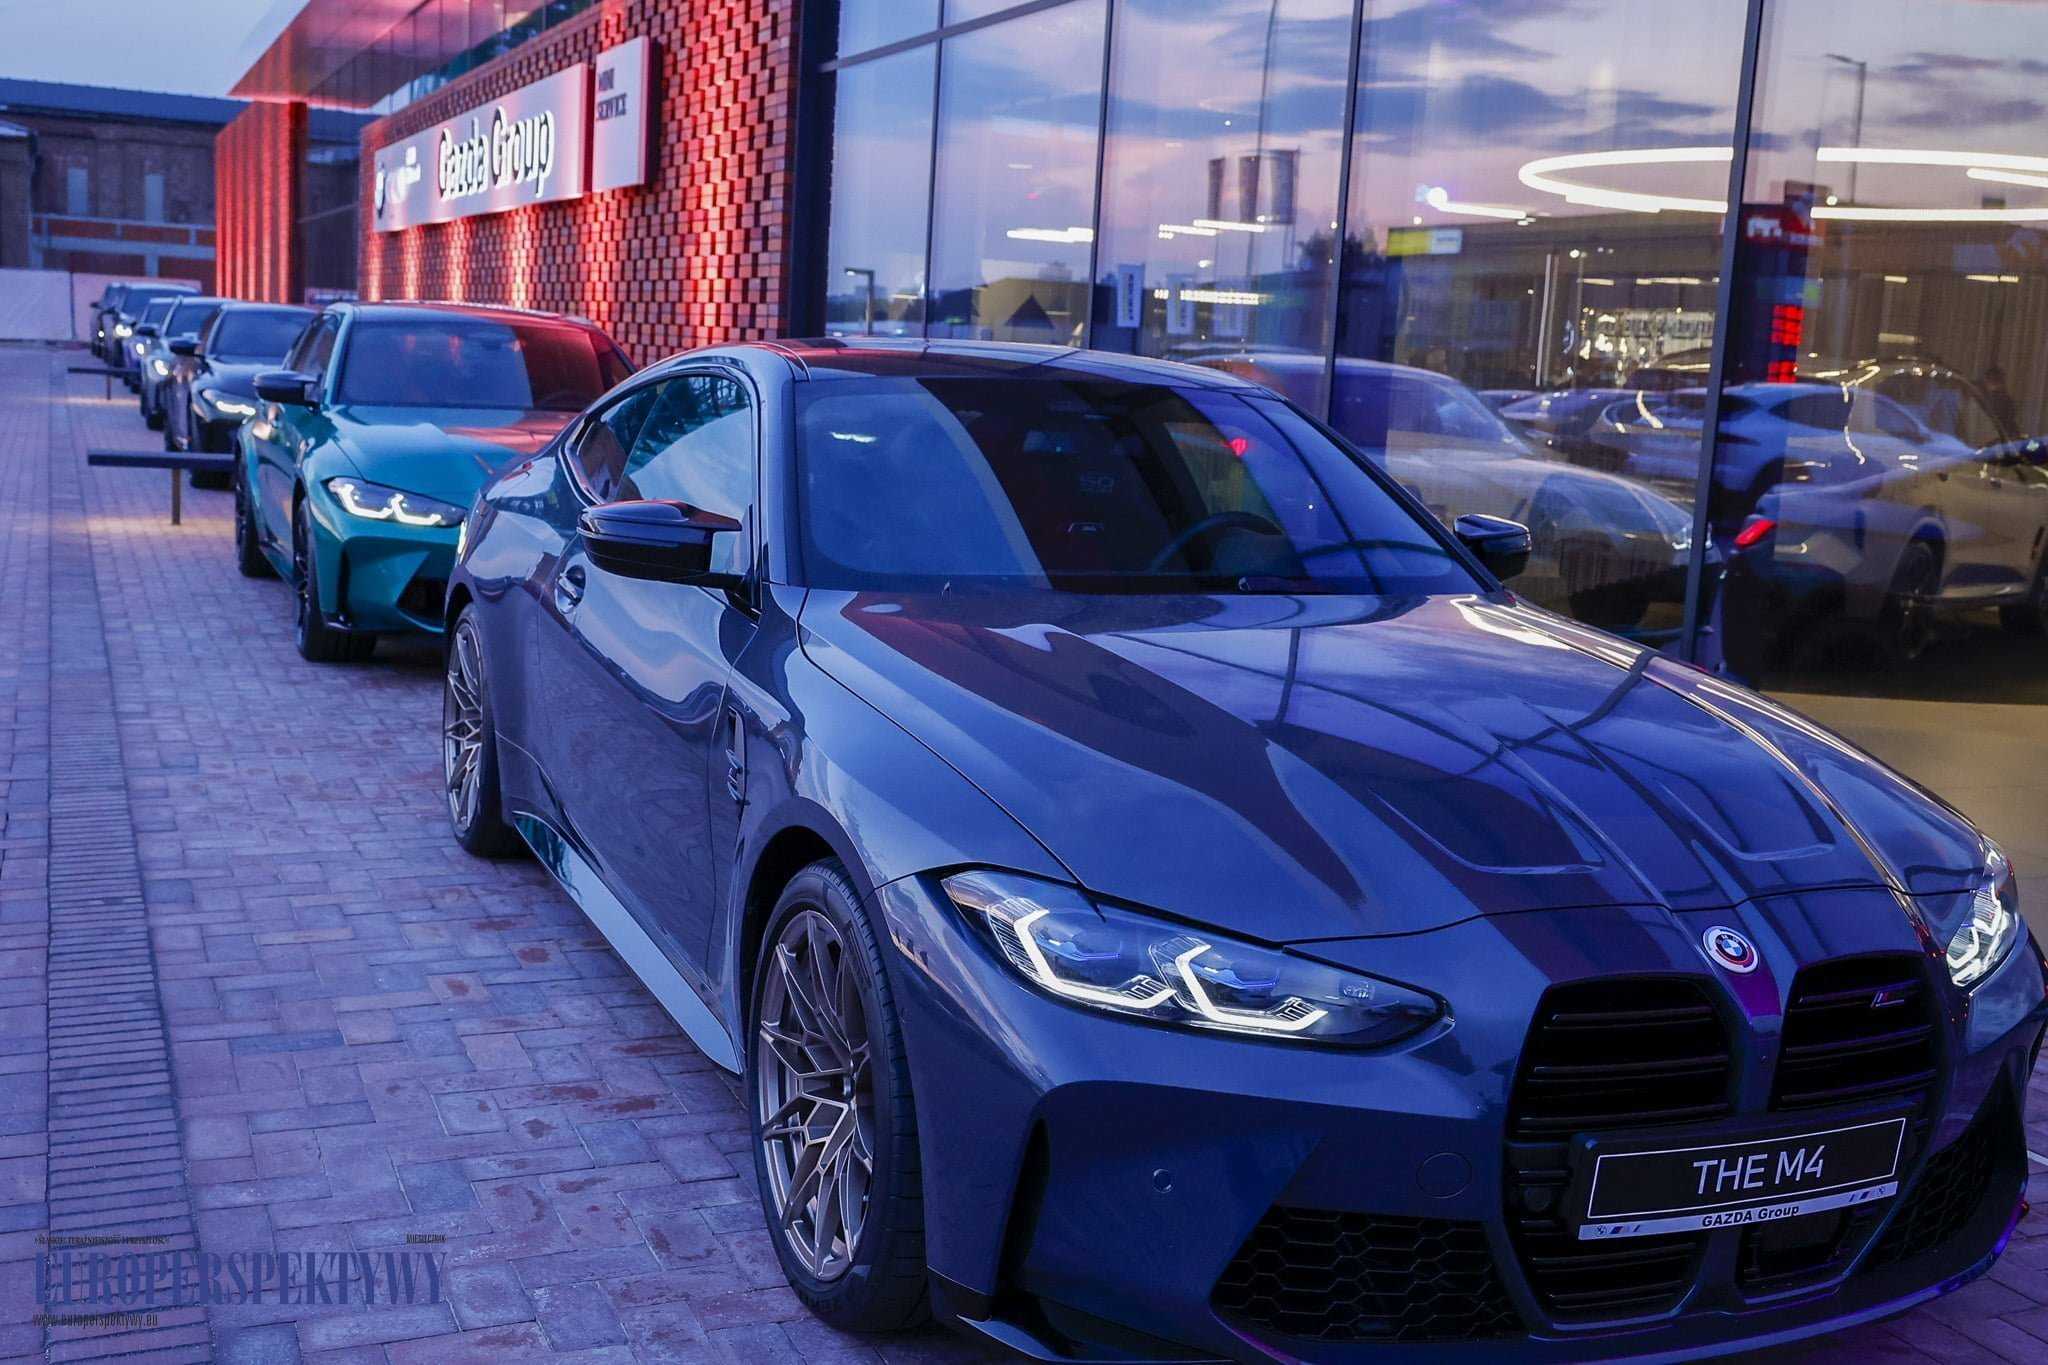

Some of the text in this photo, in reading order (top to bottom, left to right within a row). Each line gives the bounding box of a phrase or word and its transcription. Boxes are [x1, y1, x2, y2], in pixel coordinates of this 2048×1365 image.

[437, 105, 556, 202] Gazda Group
[1693, 1144, 1827, 1195] THE M4
[1701, 1204, 1800, 1228] GAZDA Group
